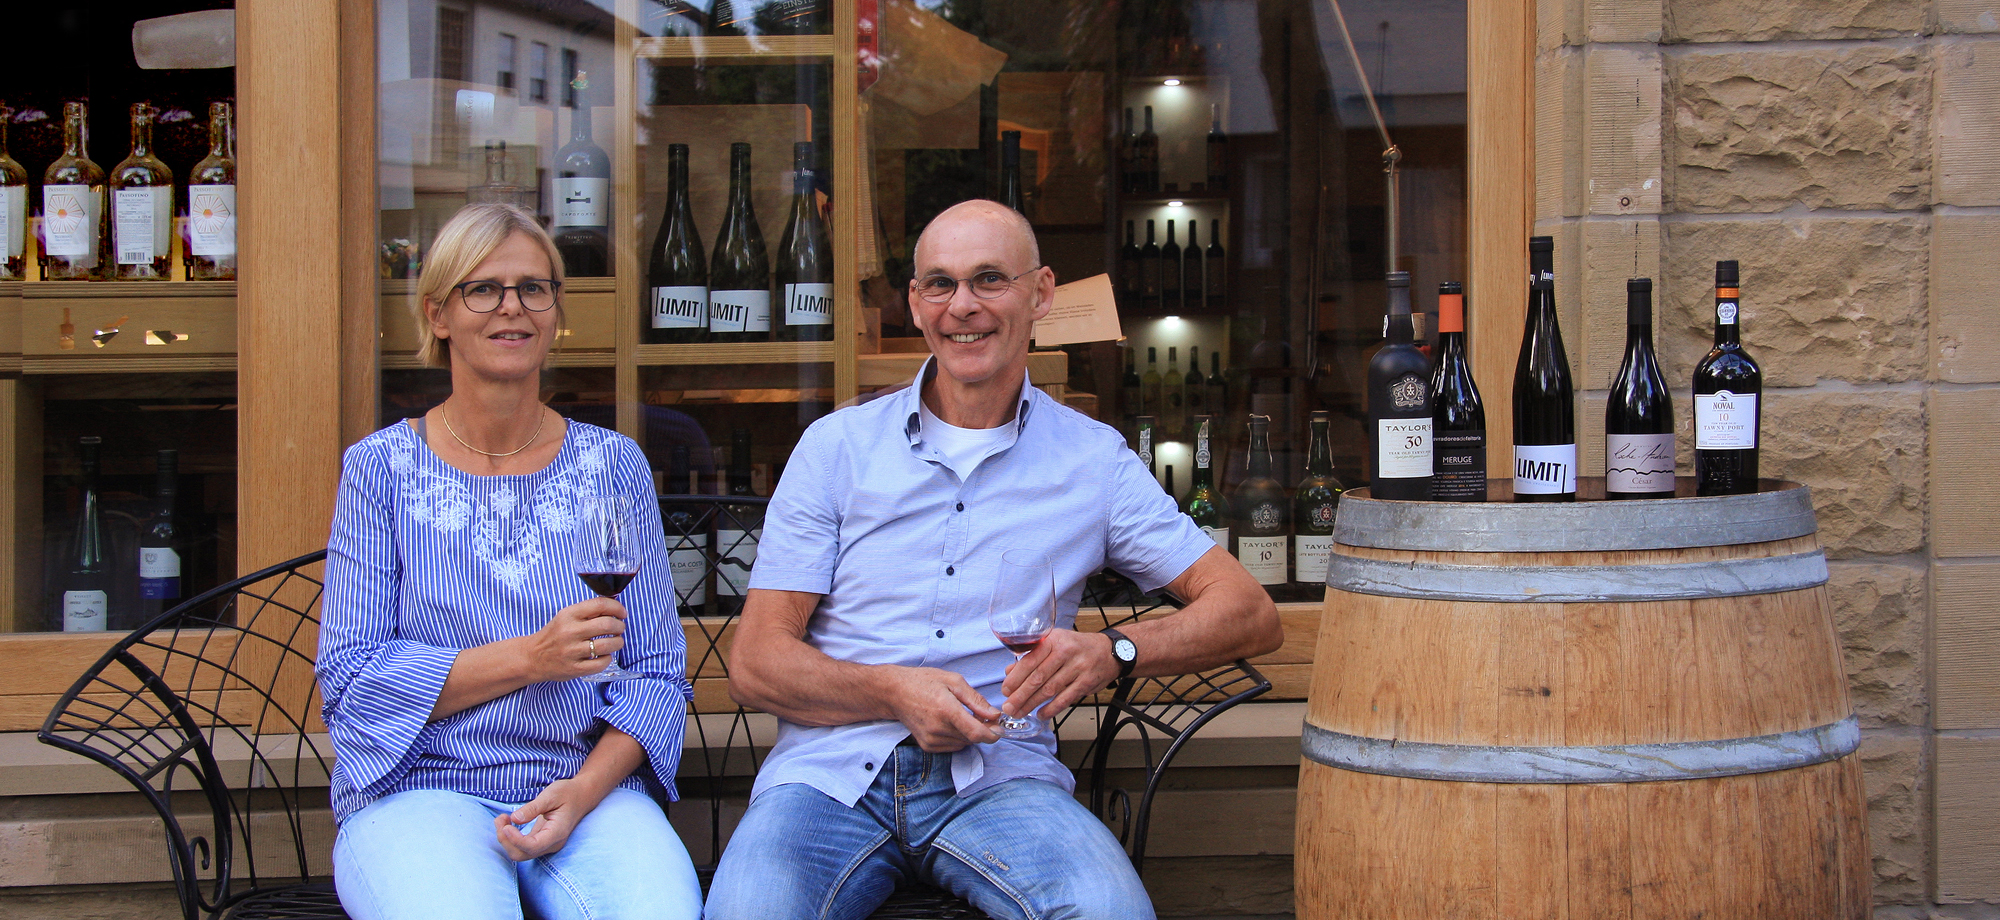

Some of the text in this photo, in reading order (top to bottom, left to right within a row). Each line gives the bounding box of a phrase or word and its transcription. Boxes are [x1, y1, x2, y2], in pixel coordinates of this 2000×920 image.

[659, 297, 700, 318] LIMIT
[797, 294, 833, 315] LIMIT
[711, 302, 744, 322] LIMIT
[1712, 402, 1735, 410] NOVAL
[1719, 413, 1729, 421] 10
[1385, 424, 1431, 432] TAYLOR'S
[1404, 435, 1422, 450] 30
[1442, 456, 1473, 464] MERUGE
[1517, 457, 1562, 482] LIMIT
[1632, 477, 1653, 485] César
[1260, 550, 1272, 562] 10
